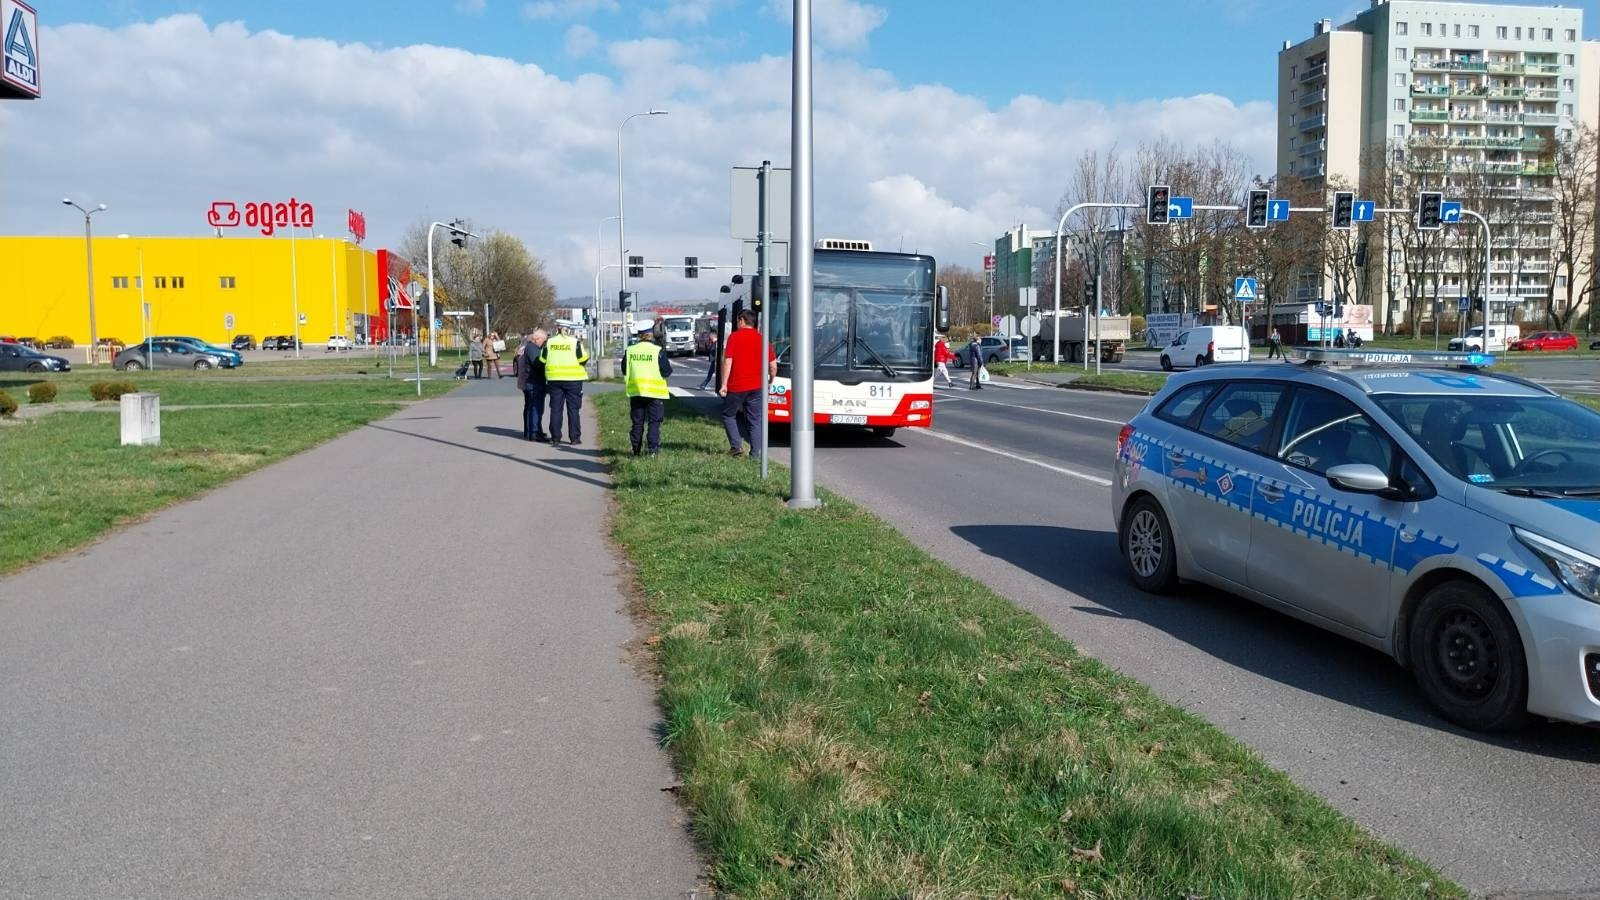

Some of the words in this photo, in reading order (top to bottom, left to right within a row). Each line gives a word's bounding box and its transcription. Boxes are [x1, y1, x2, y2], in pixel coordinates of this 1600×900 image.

[8, 59, 34, 84] ALDI
[245, 197, 313, 236] agata
[629, 353, 653, 362] POLICJA
[1367, 354, 1409, 363] POLICJA
[870, 385, 892, 397] 811
[832, 399, 867, 407] MAN
[1291, 499, 1364, 548] POLICJA
